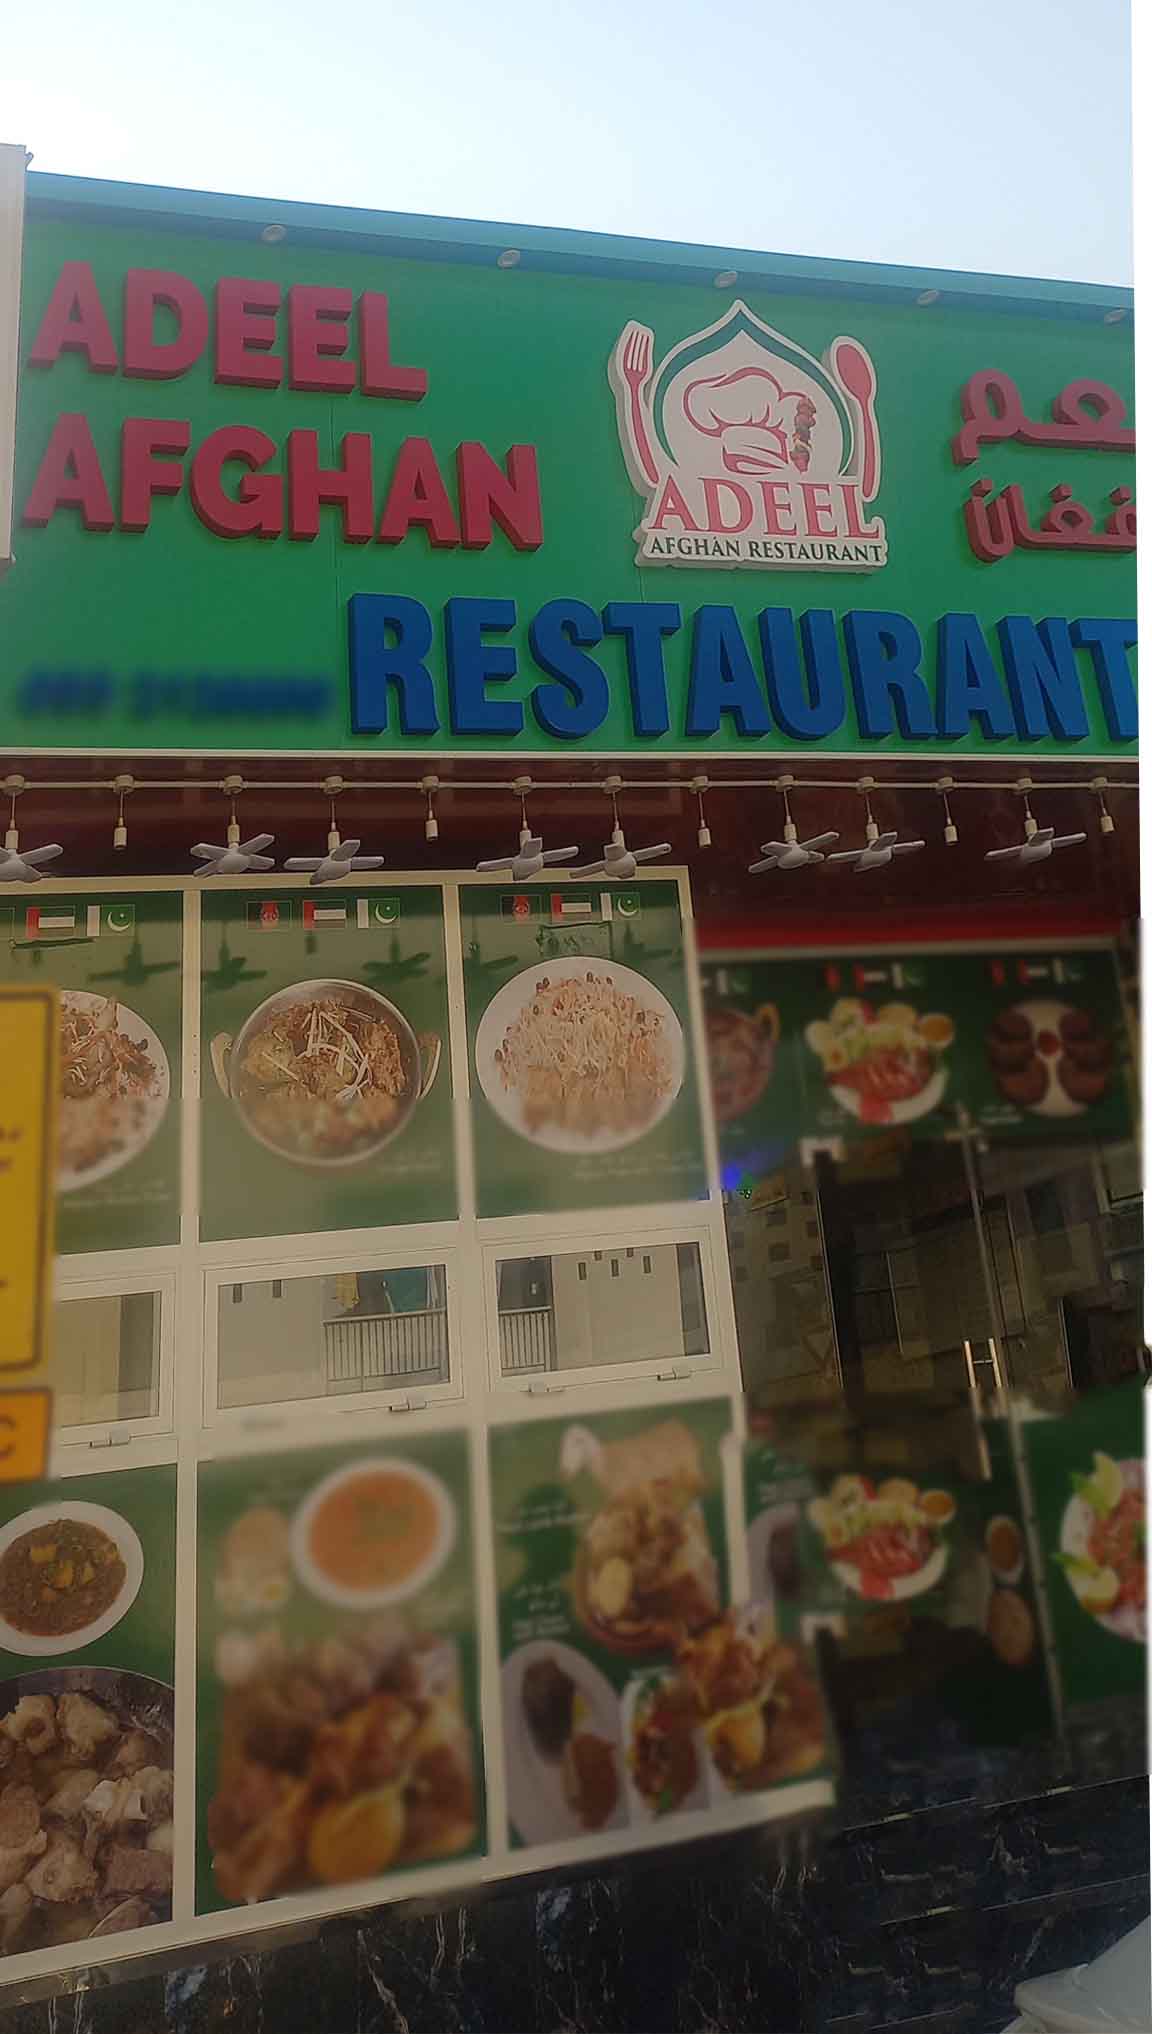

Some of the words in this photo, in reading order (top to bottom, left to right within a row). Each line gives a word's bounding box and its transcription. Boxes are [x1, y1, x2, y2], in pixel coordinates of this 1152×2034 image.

[28, 260, 428, 401] ADEEL
[953, 368, 1137, 466] عم
[22, 412, 544, 552] AFGHAN
[648, 474, 880, 539] ADEEL
[650, 535, 741, 557] AFGHAN
[749, 540, 883, 563] RESTAURANT
[347, 592, 1139, 743] RESTAURANT
